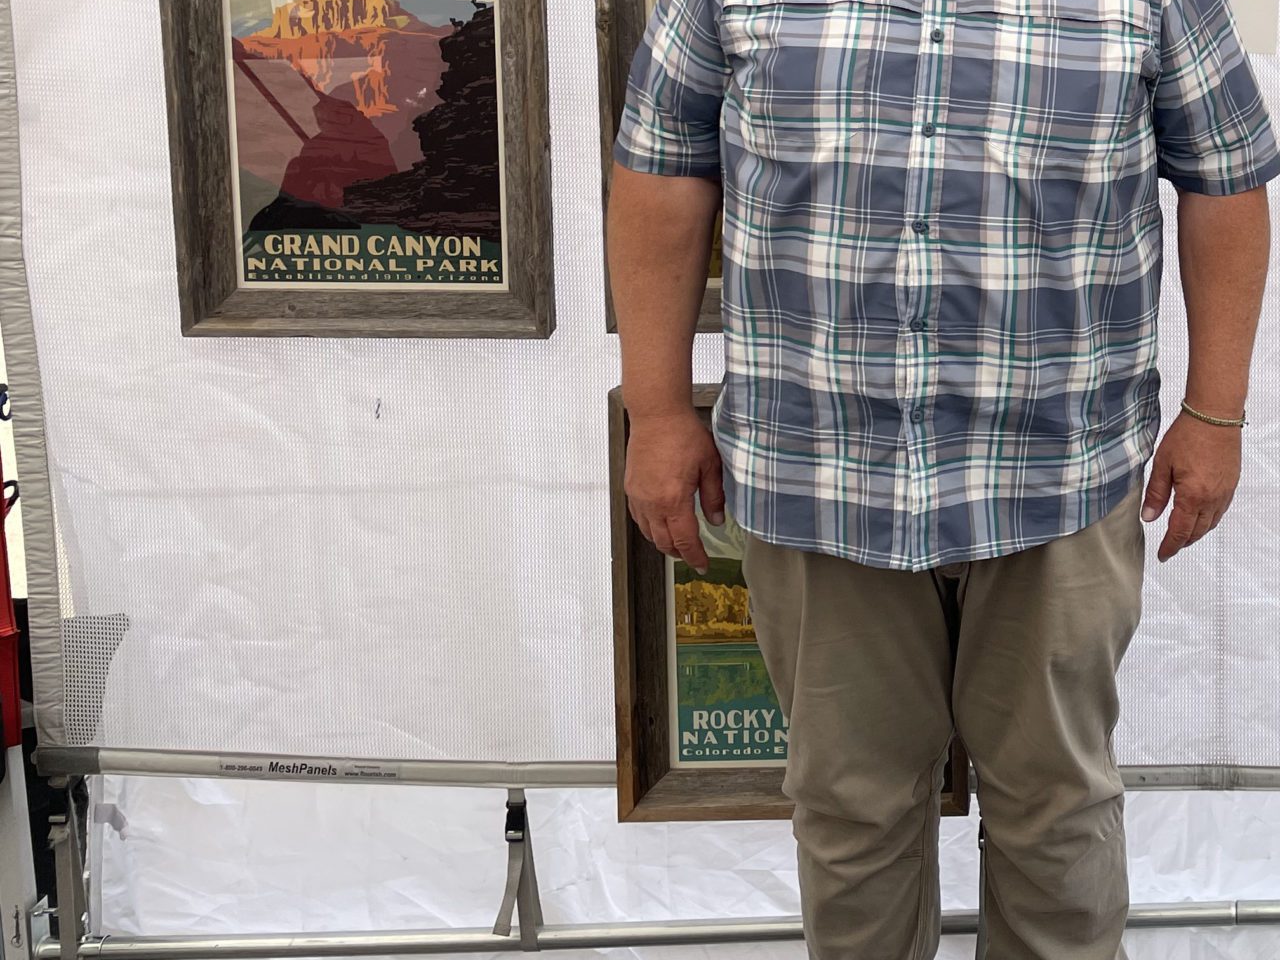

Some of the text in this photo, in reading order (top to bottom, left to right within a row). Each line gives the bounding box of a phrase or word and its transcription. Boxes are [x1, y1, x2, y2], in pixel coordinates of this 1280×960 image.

[264, 234, 481, 257] GRAND CANYON
[247, 257, 499, 273] NATIONAL PARK
[247, 272, 500, 281] Established 1919 Arizona
[692, 708, 776, 730] ROCKY
[682, 729, 789, 745] NATION
[682, 746, 761, 756] Colorado
[268, 761, 338, 776] MeshPanels
